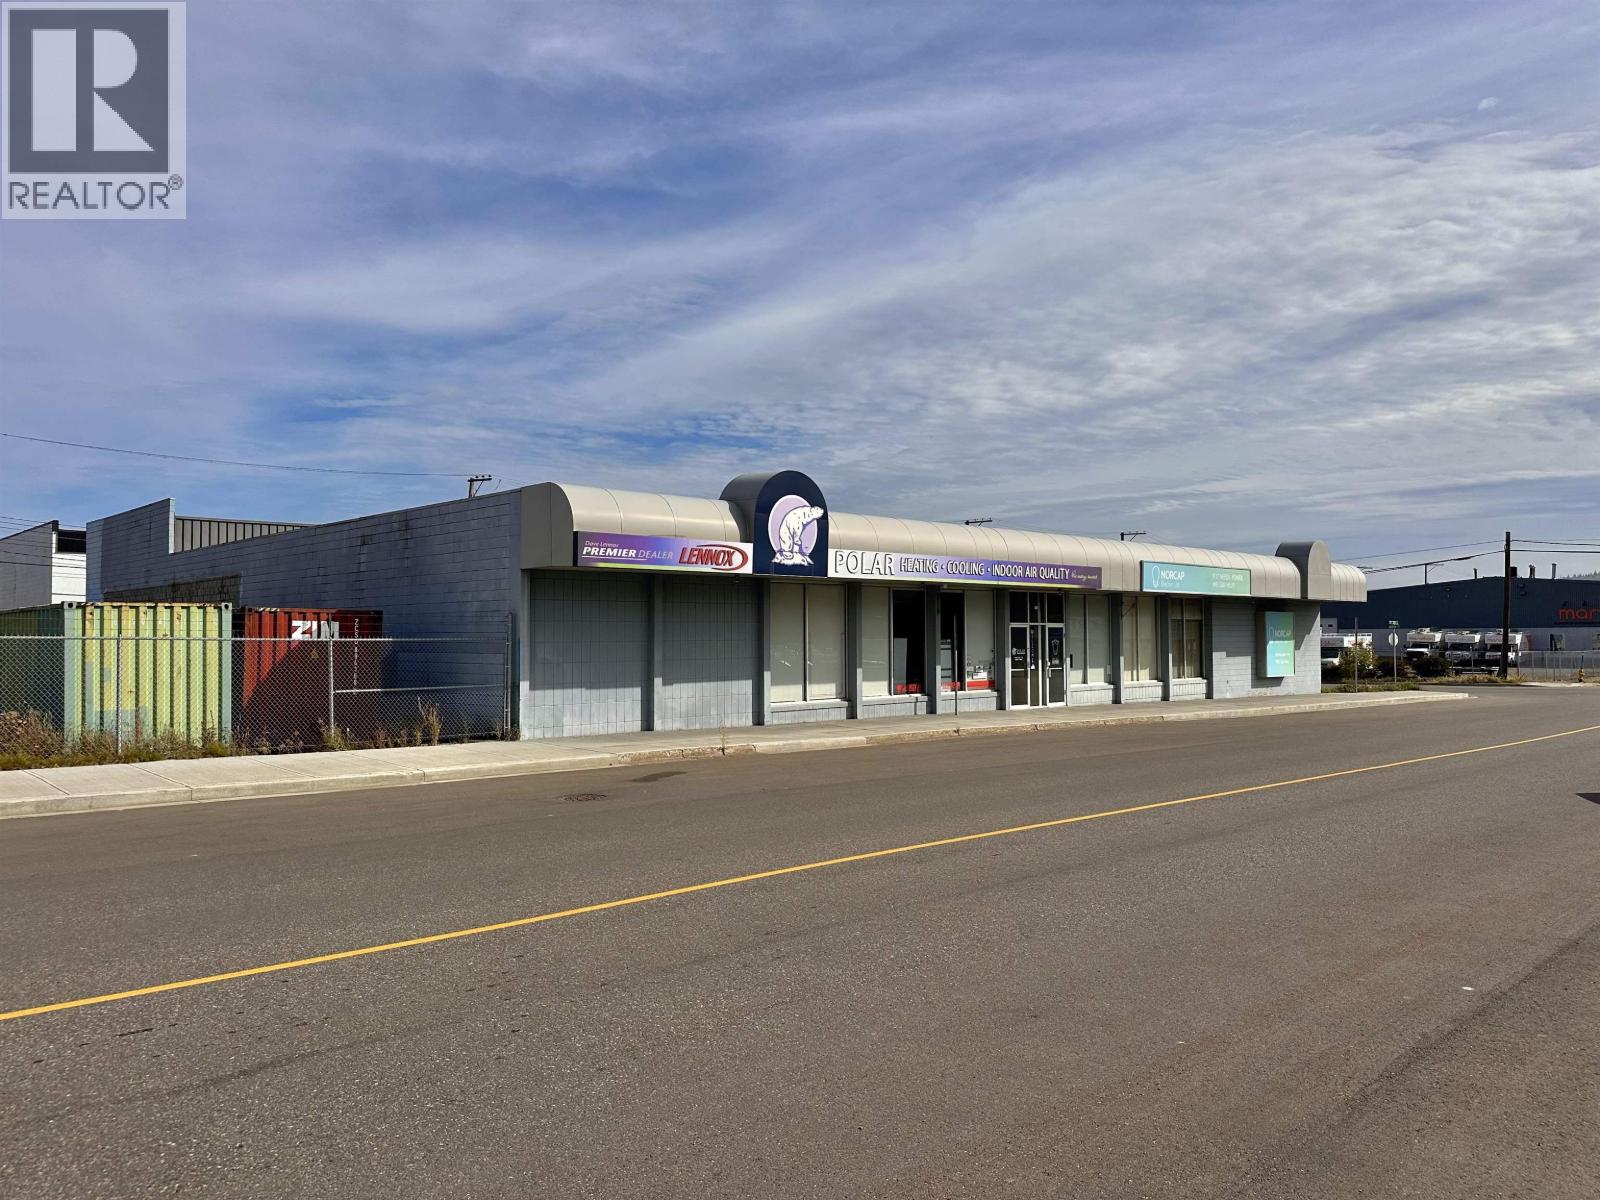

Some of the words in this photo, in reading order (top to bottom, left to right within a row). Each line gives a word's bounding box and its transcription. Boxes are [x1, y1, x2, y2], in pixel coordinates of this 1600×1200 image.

[582, 546, 637, 558] PREMIER
[638, 549, 674, 560] DEALER
[678, 547, 736, 567] LENNOX
[834, 550, 895, 576] POLAR
[900, 557, 939, 574] HEATING
[946, 560, 985, 576] COOLING
[991, 564, 1023, 578] INDOOR
[1024, 566, 1038, 579] AIR
[1039, 567, 1070, 580] QUALITY
[1160, 569, 1185, 581] NORCAP
[291, 620, 340, 640] ZIM
